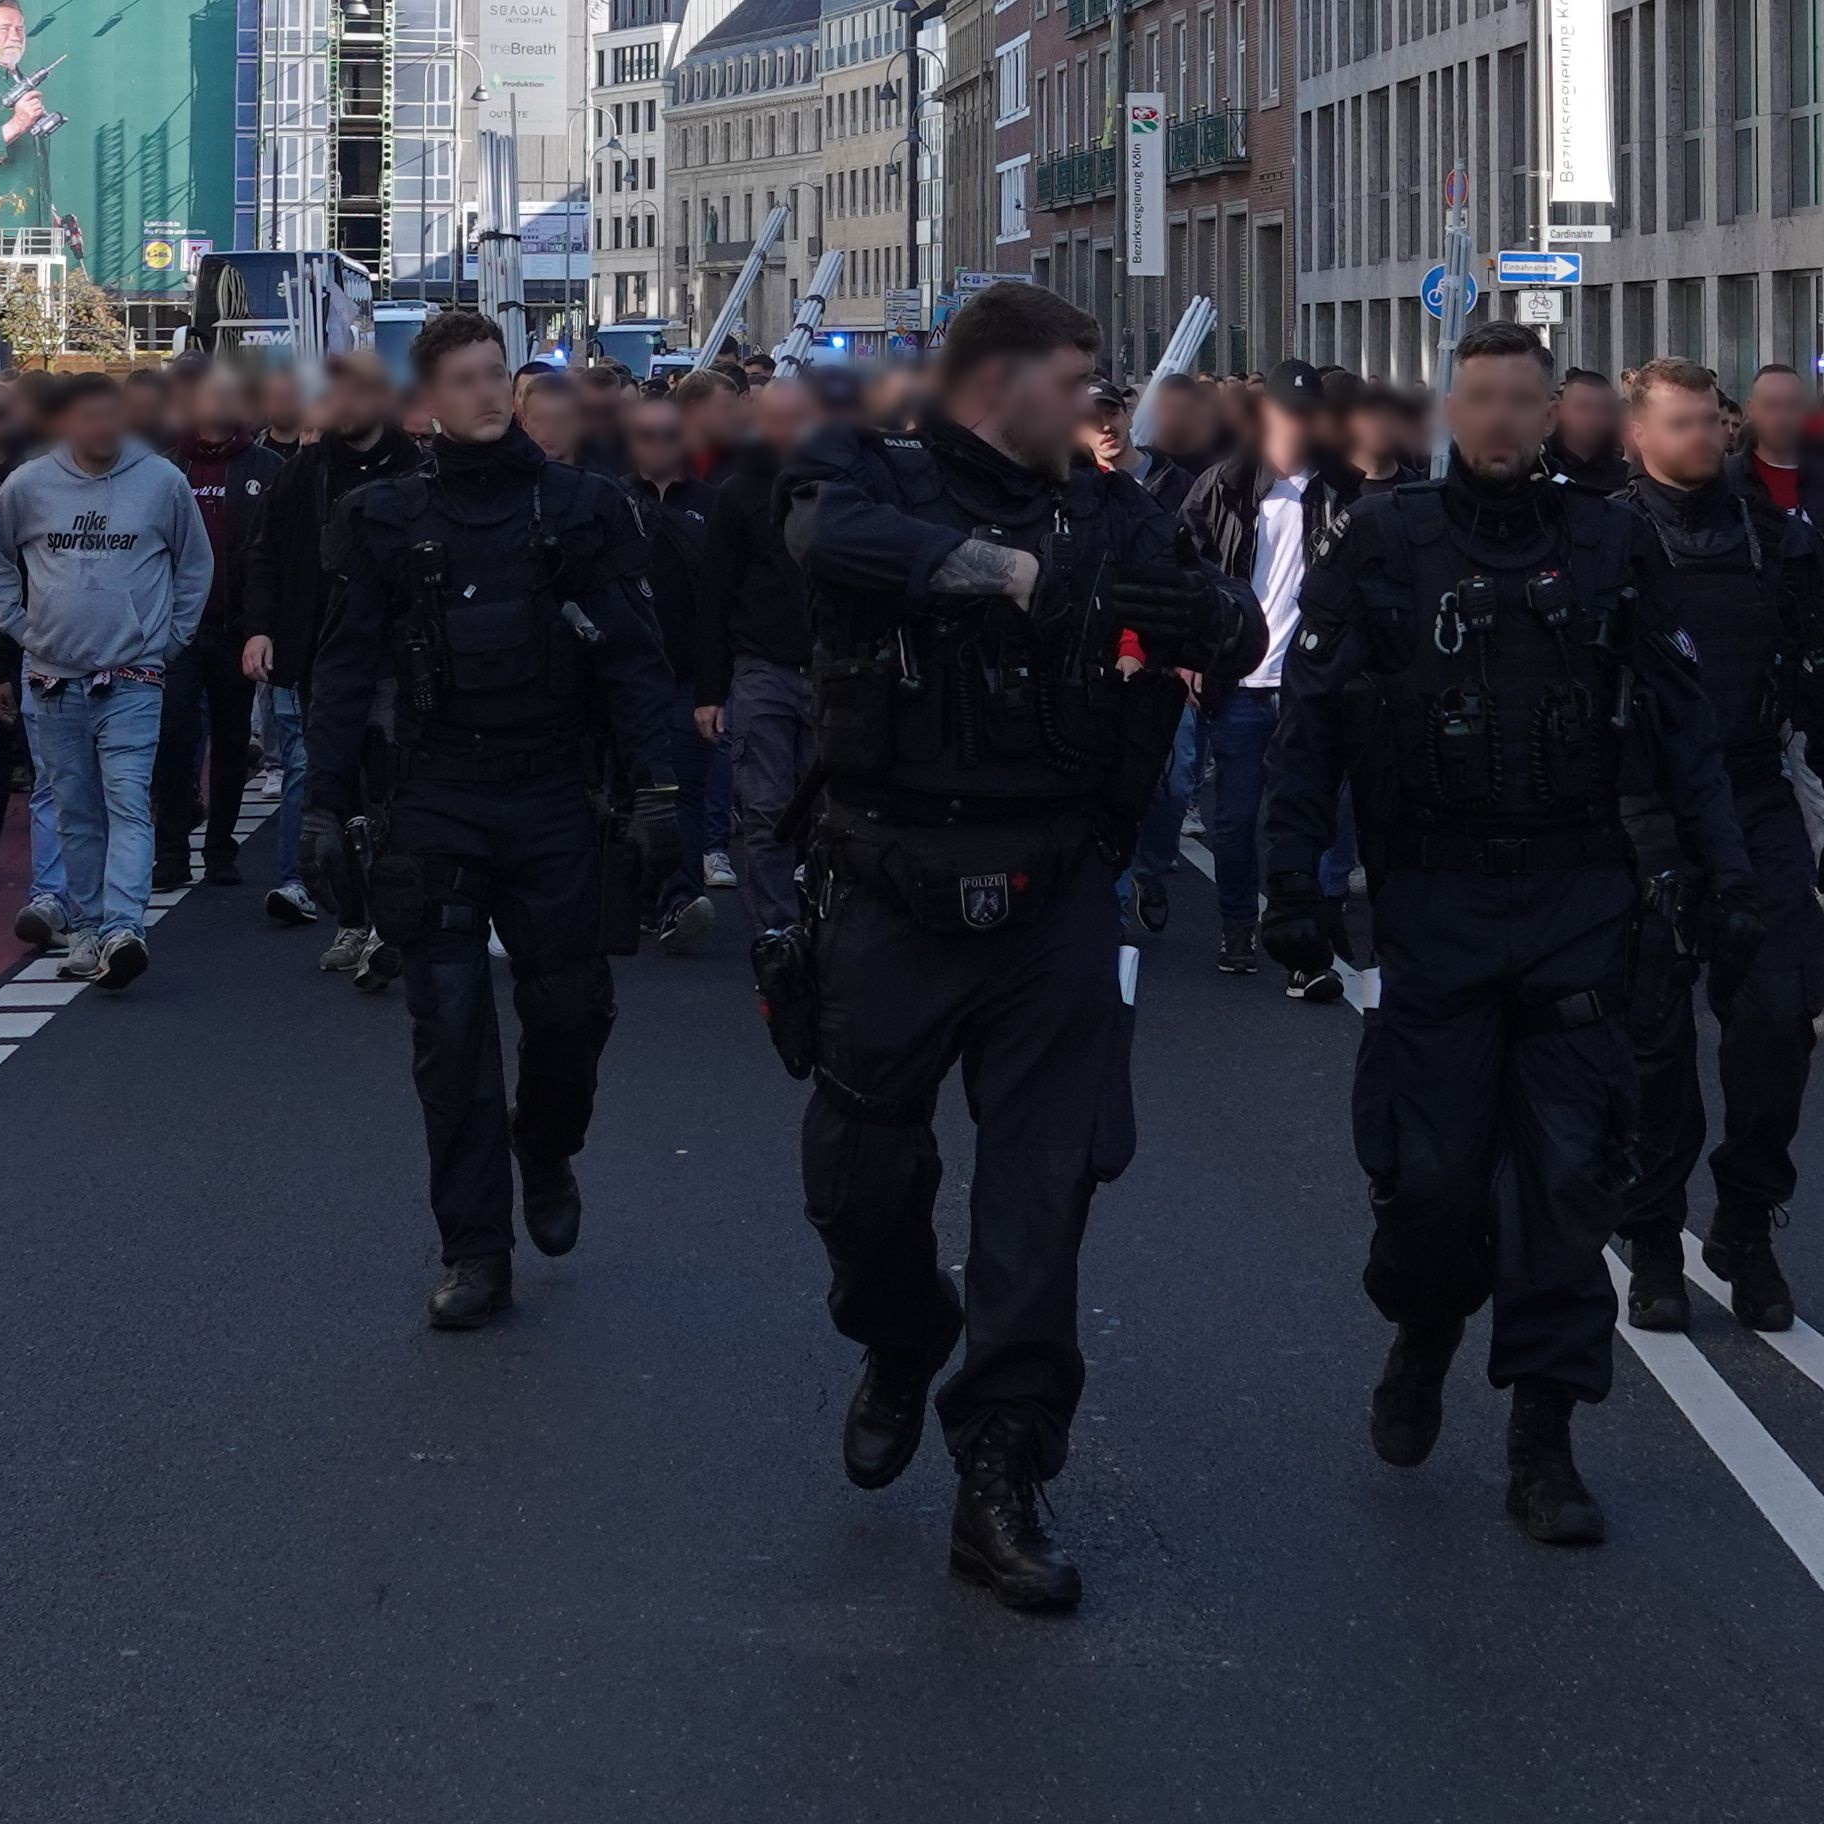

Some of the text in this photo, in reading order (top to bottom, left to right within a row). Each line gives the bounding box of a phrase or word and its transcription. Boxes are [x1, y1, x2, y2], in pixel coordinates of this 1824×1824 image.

[489, 5, 558, 17] SEAQUAL
[489, 42, 557, 55] theBreath
[1558, 24, 1576, 183] Bezirksregierung
[488, 110, 529, 119] OUTSTE
[1131, 143, 1145, 264] Bezirksregierung Köln
[883, 438, 925, 449] OLIZEI
[72, 510, 108, 531] nike
[47, 531, 139, 553] sportswear
[963, 876, 1005, 889] POLIZEI
